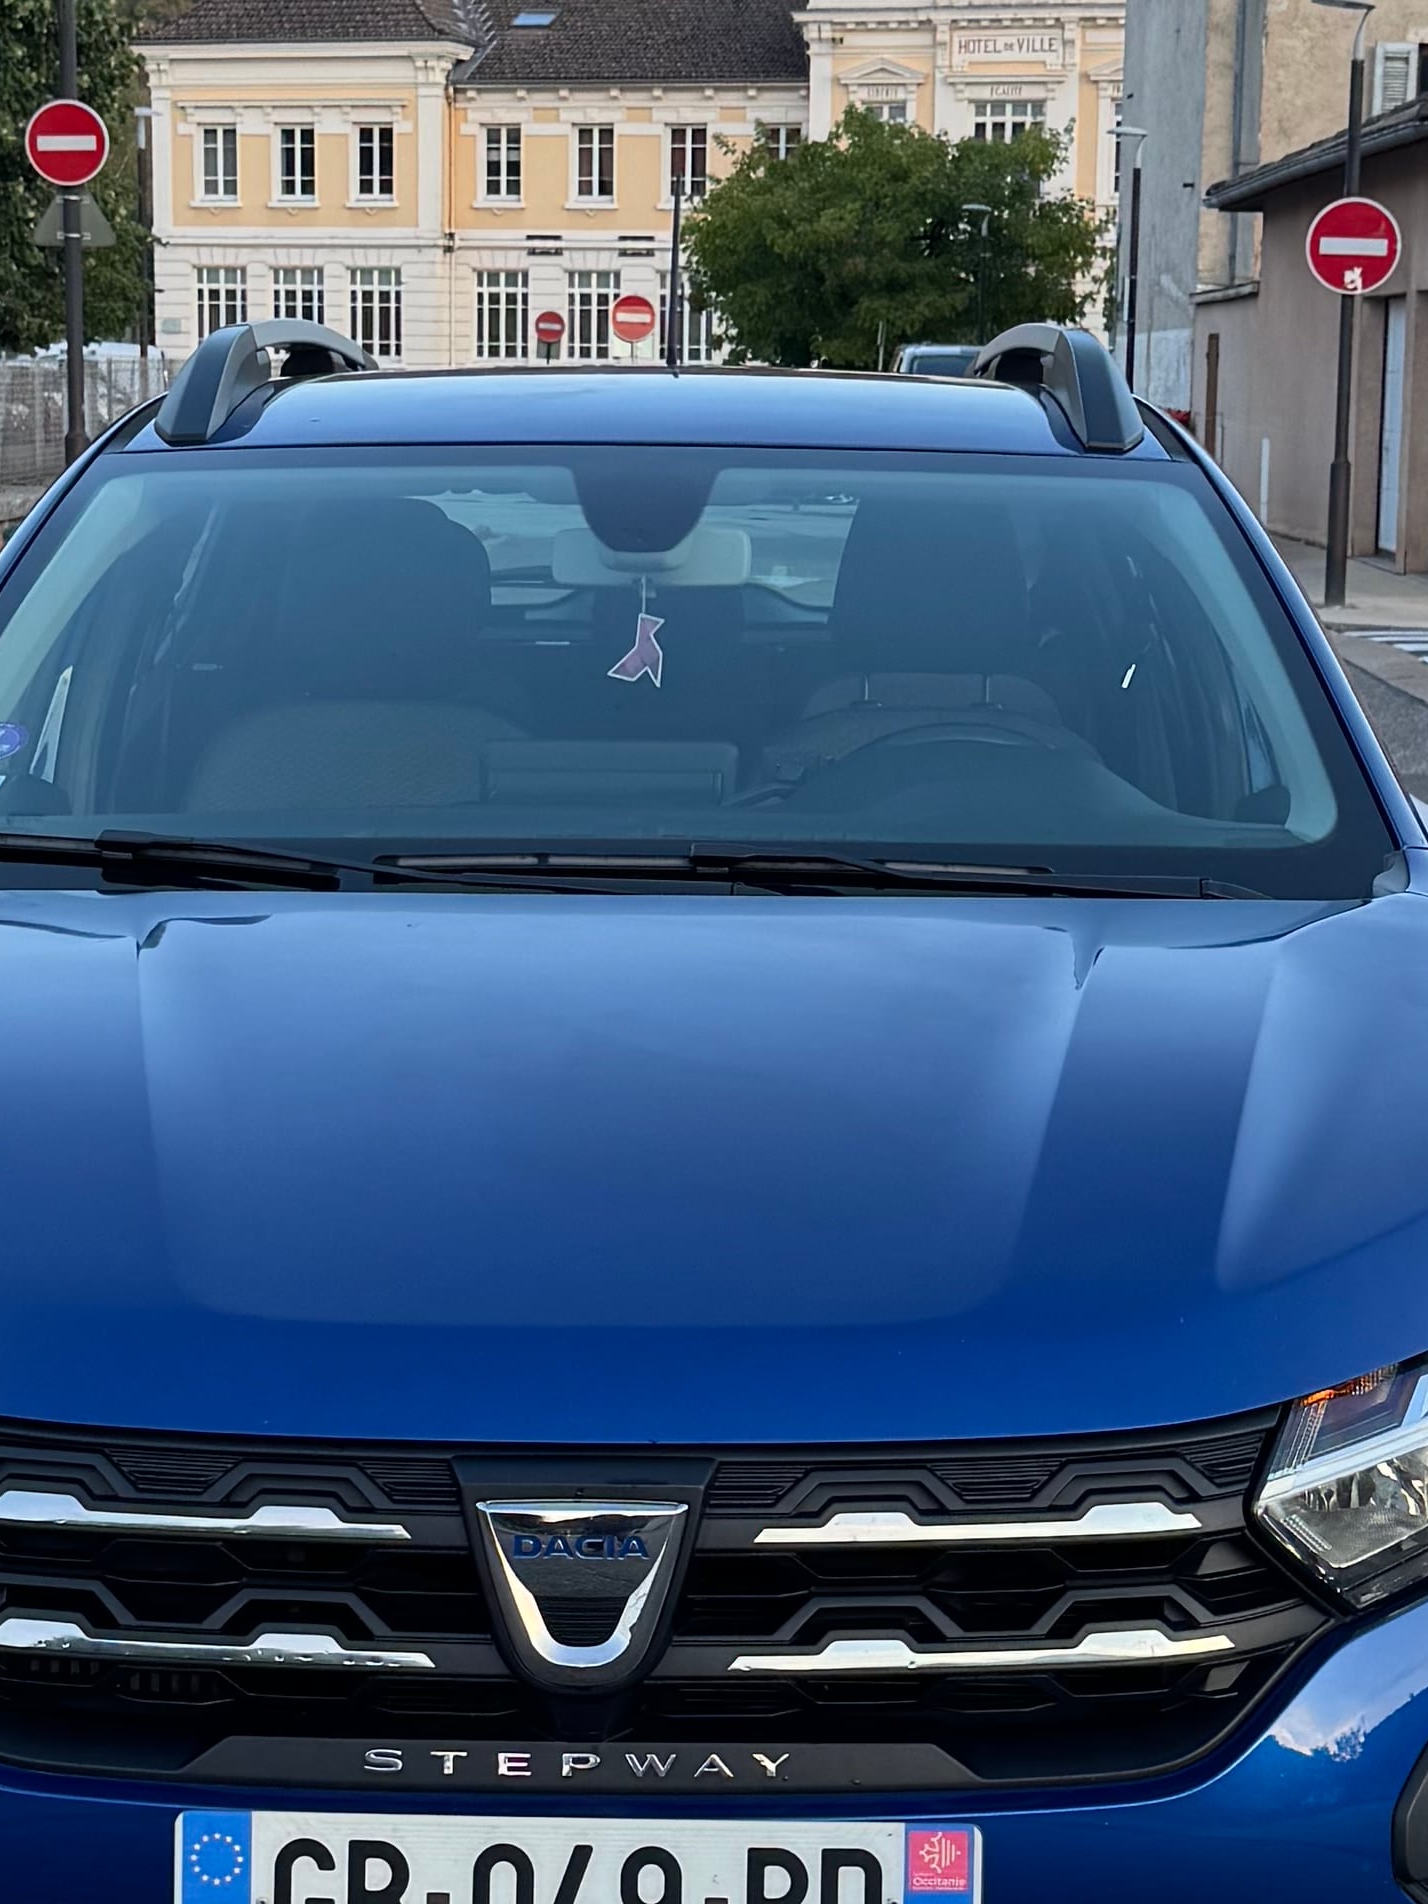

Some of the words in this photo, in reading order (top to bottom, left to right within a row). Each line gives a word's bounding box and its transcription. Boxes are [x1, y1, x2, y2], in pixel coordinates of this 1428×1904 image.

[958, 39, 1002, 54] HOTEL
[1017, 37, 1058, 53] VILLE
[513, 1535, 650, 1560] DACIA
[364, 1749, 790, 1777] STEPWAY
[912, 1875, 968, 1886] Occitanie
